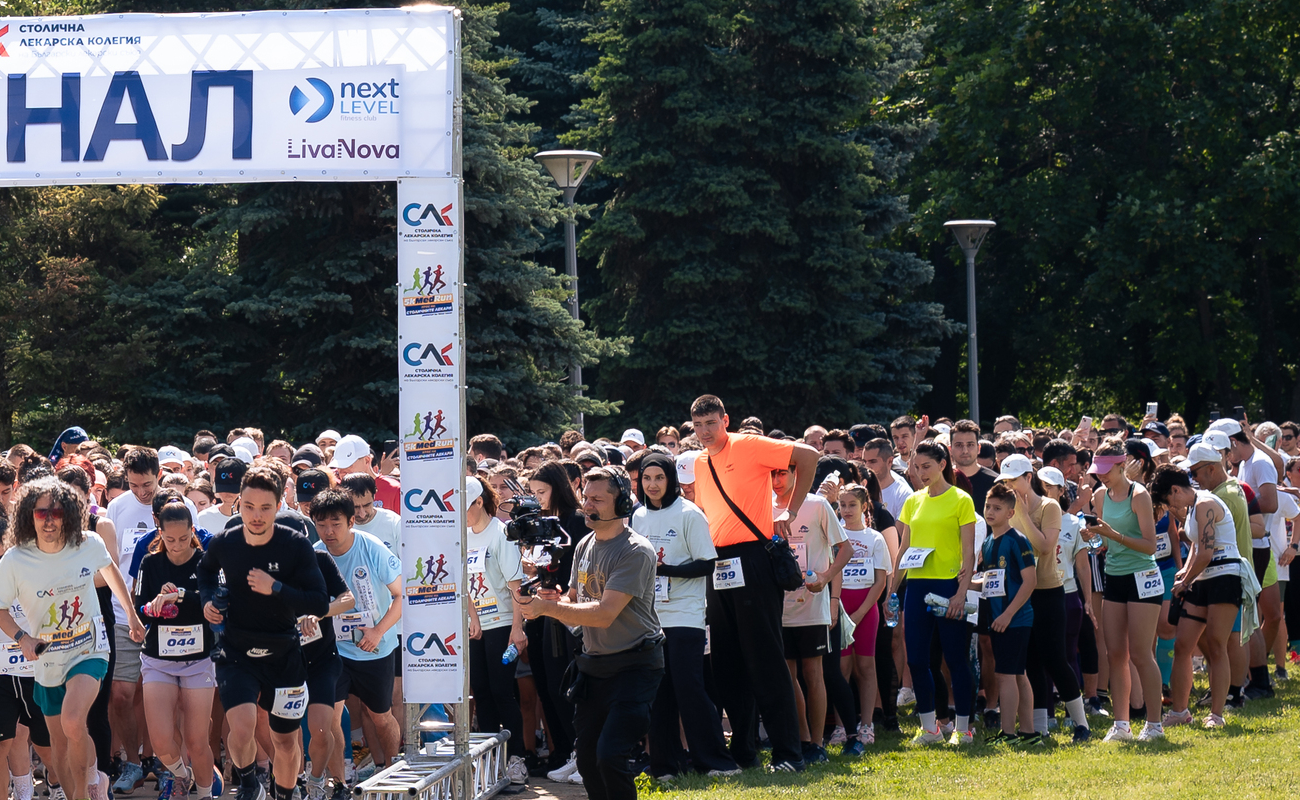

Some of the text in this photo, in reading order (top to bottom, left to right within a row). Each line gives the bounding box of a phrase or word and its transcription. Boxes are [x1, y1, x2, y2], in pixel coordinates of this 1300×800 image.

[19, 24, 85, 33] СТОЛИЧНА
[19, 36, 141, 47] ЛЕКАРСКА КОЛЕГИЯ
[340, 78, 399, 98] next
[340, 101, 399, 114] LEVEL
[288, 139, 400, 158] LivaNova
[1156, 543, 1166, 551] 52
[467, 556, 478, 565] 61
[716, 571, 736, 581] 299
[844, 568, 867, 577] 520
[167, 638, 196, 647] 044
[251, 647, 269, 655] NIKE
[9, 654, 28, 664] 01
